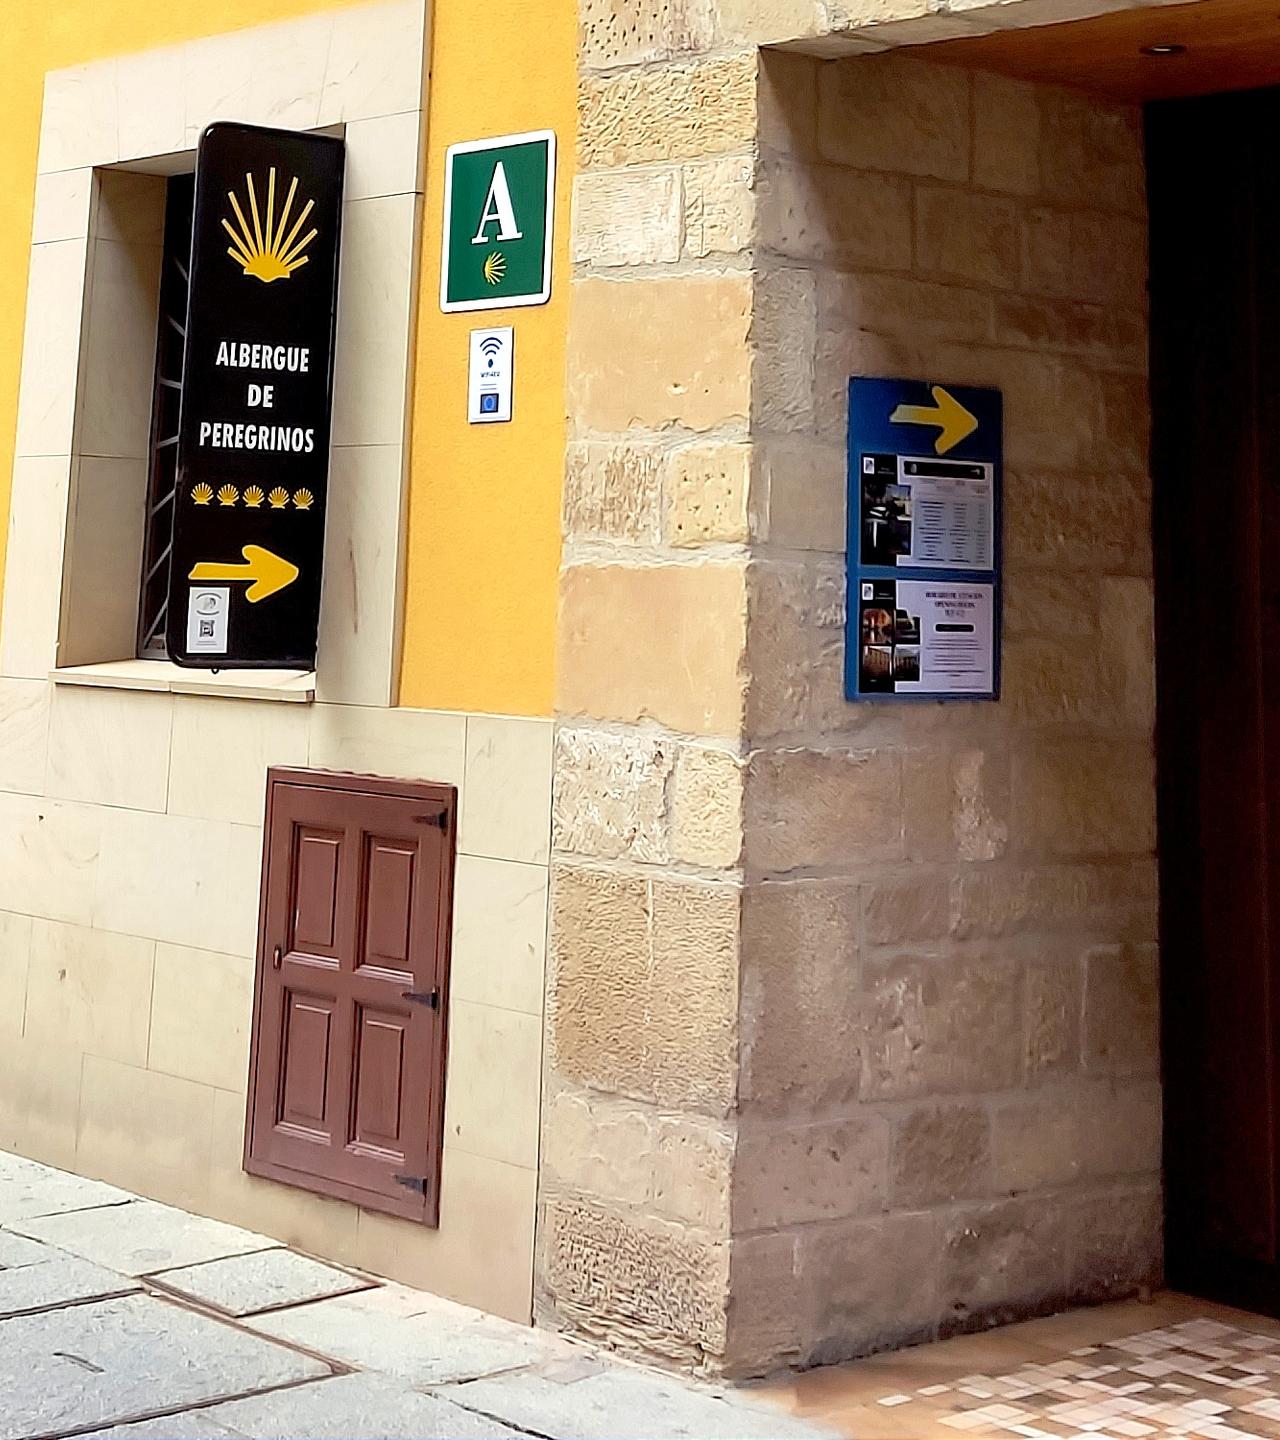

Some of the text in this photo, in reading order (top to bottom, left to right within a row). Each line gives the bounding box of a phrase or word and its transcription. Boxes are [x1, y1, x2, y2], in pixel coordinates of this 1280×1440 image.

[471, 160, 523, 245] A
[216, 341, 310, 374] ALBERGUE
[247, 384, 274, 409] DE
[199, 421, 315, 453] PEREGRINOS
